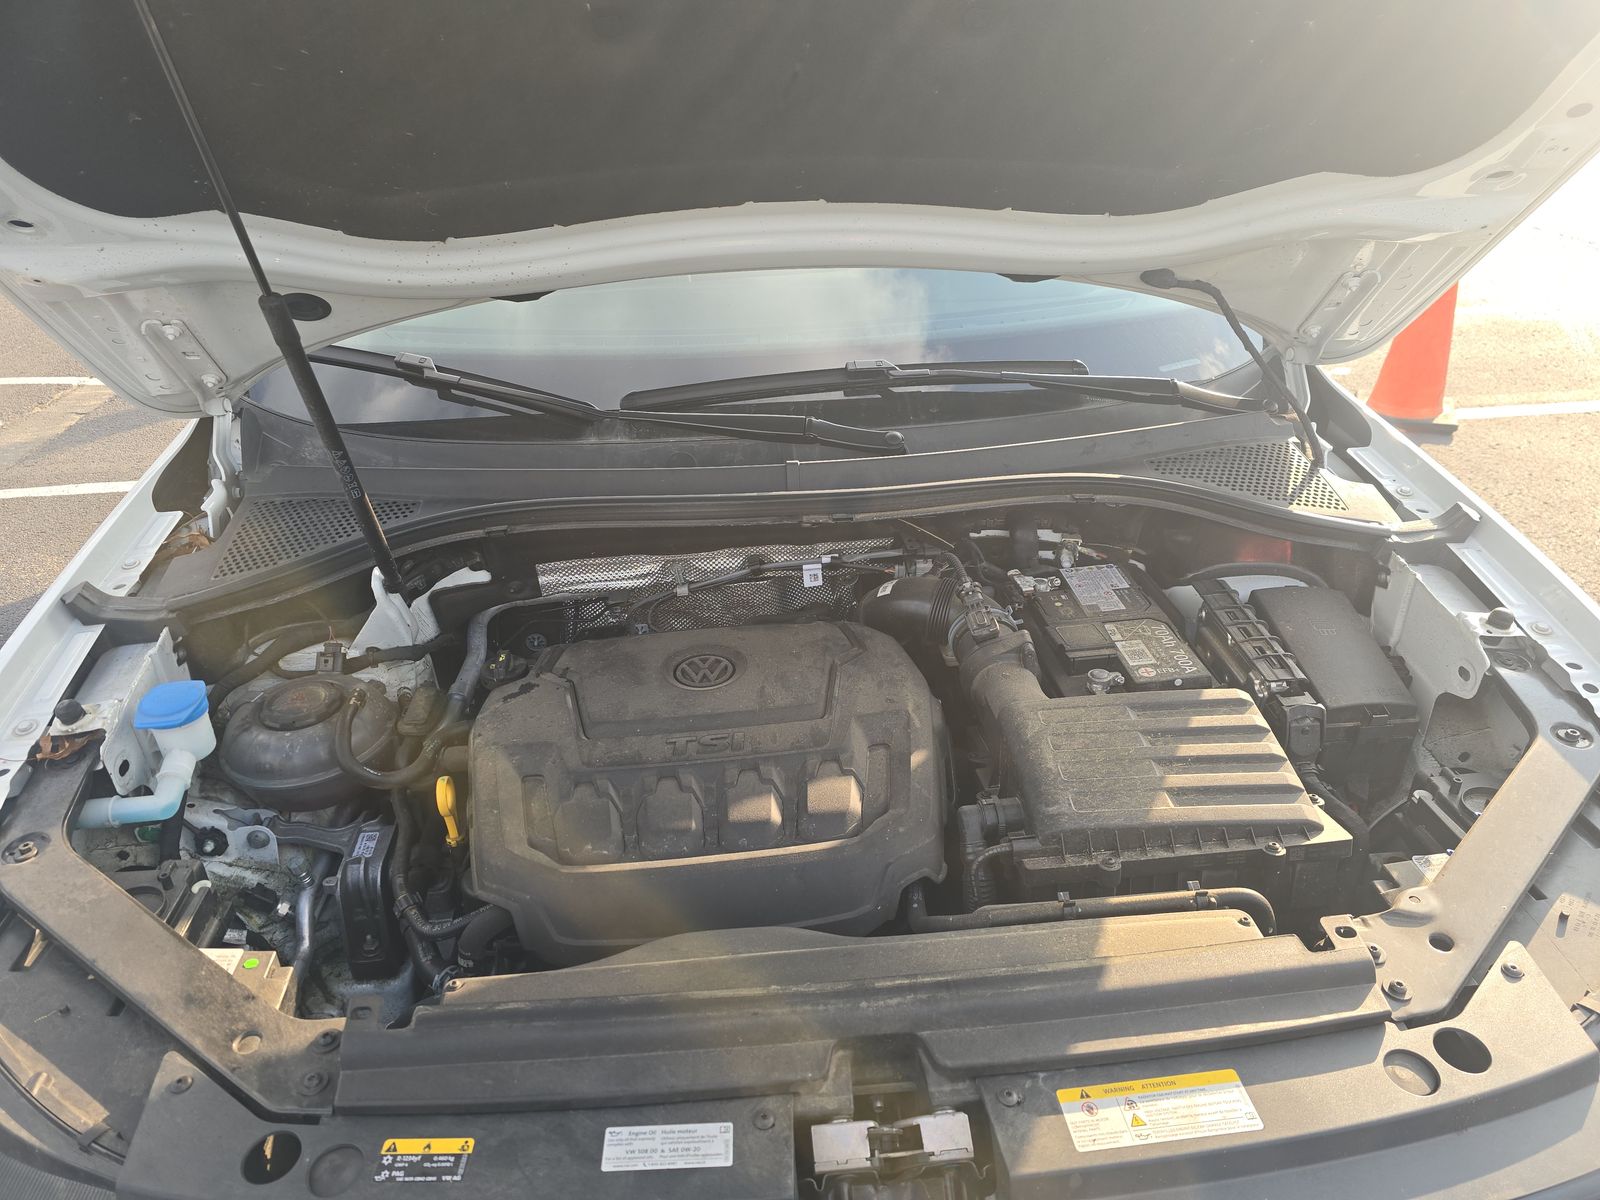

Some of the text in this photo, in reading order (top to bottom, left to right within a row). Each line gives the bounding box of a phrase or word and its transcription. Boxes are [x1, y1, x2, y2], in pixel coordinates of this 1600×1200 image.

[1151, 624, 1175, 647] 70Ah
[1170, 648, 1198, 674] 700A
[666, 732, 746, 756] TSI
[1103, 1079, 1177, 1095] WARNING ATTENTION
